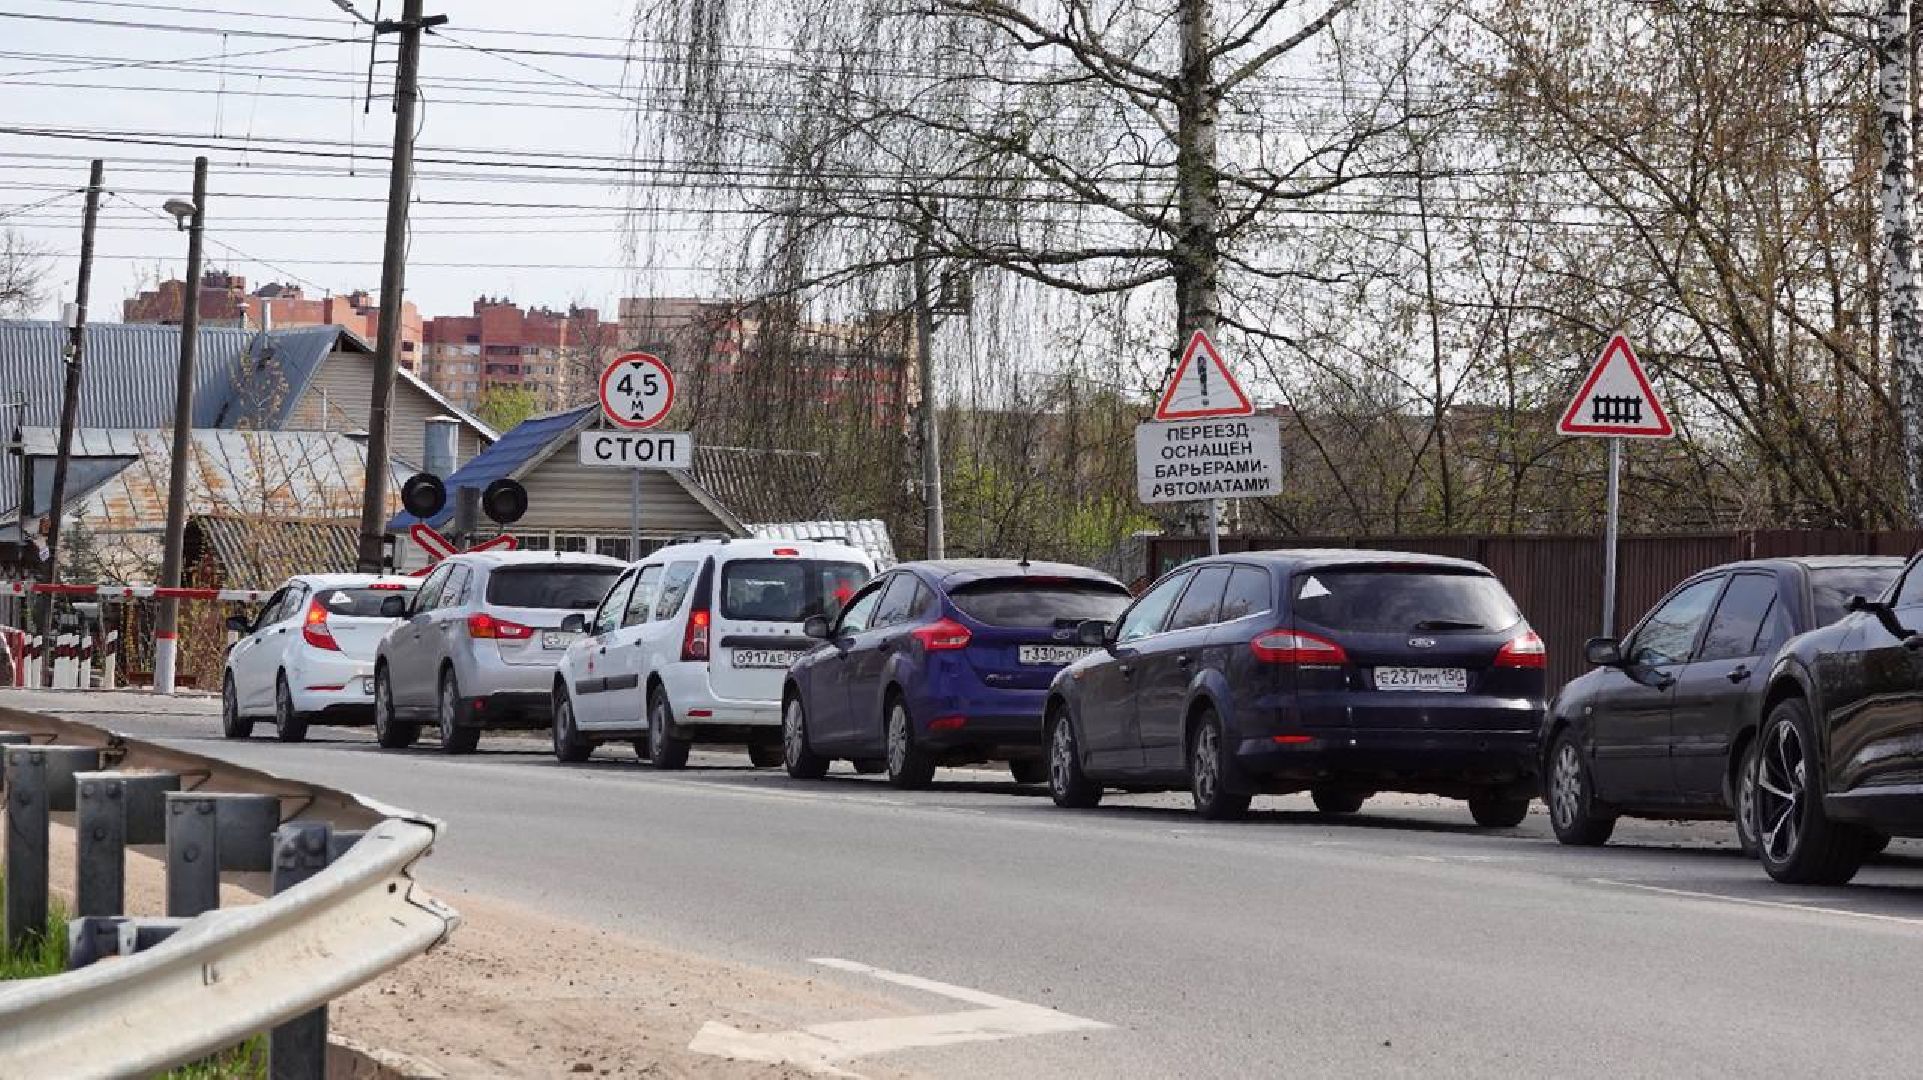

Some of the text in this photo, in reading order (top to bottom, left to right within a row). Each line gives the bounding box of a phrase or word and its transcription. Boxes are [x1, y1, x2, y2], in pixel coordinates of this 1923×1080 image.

[617, 373, 659, 399] 4,5
[1166, 422, 1250, 441] ПЕРЕЕЗД
[595, 437, 675, 462] СТОП
[1161, 440, 1253, 460] ОСНАЩЕН
[1155, 458, 1269, 478] БАРЬЕРАМИ-
[1152, 477, 1270, 498] АВТОМАТАМИ
